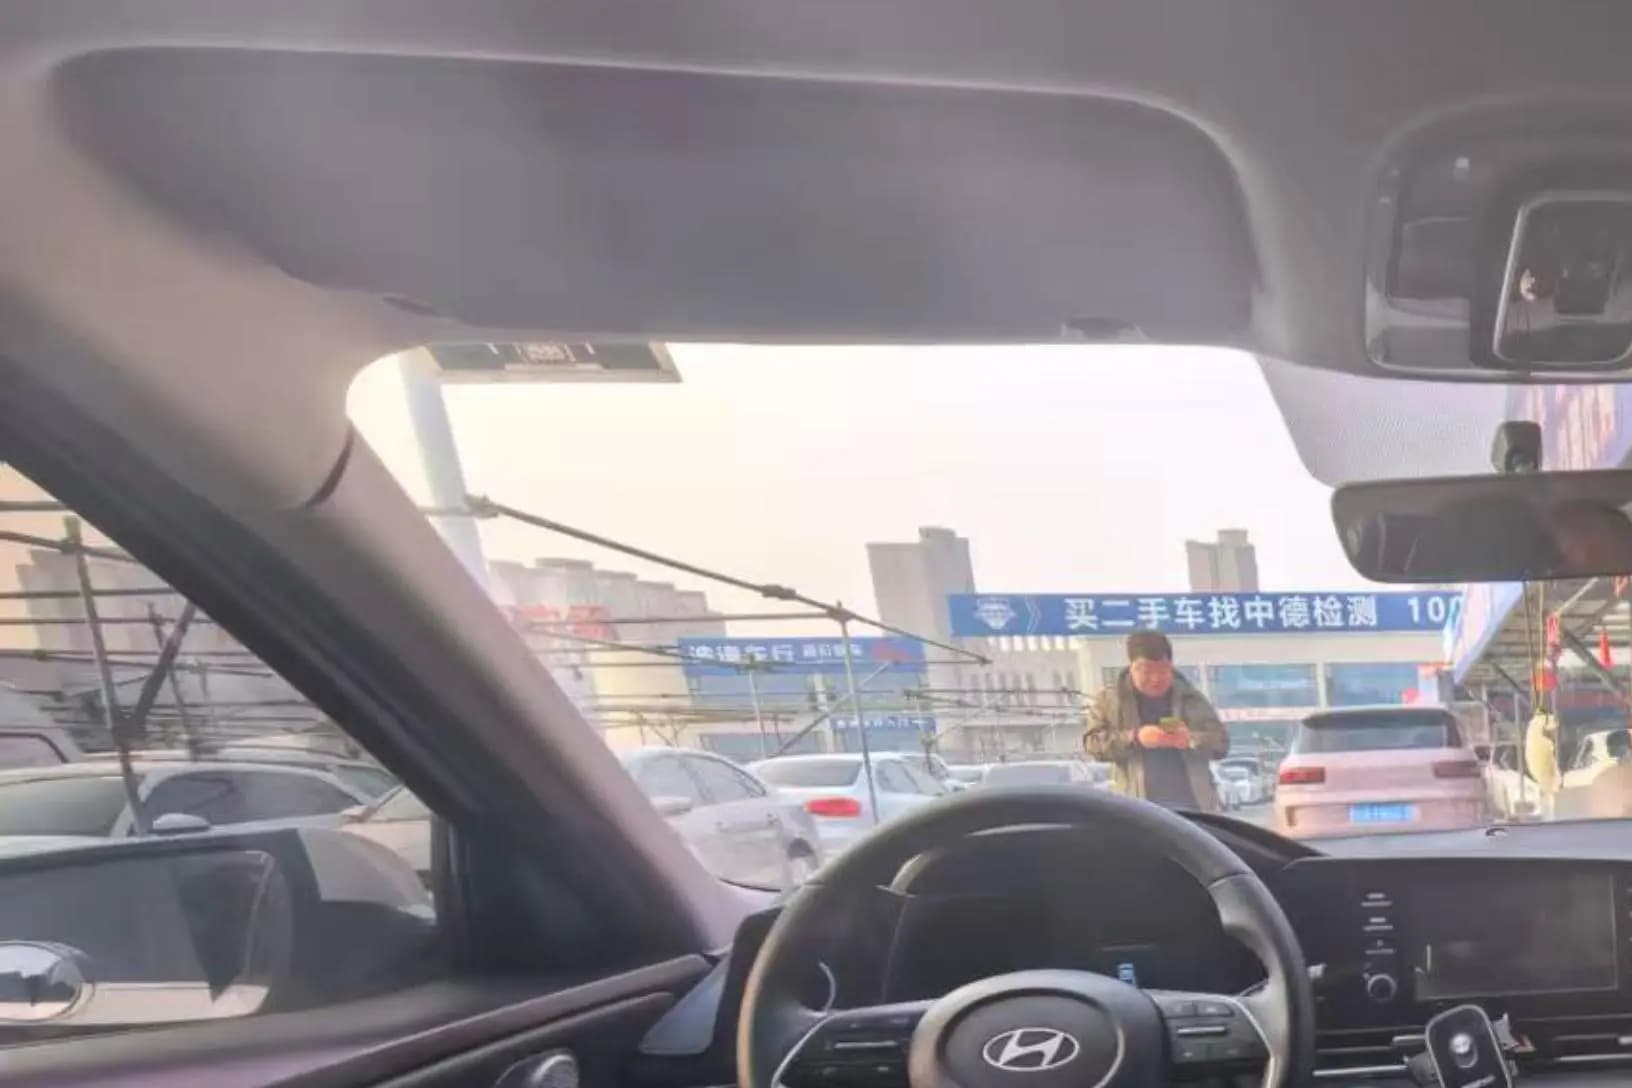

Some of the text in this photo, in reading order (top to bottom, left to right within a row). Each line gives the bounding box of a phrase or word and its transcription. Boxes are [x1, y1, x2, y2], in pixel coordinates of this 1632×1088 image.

[1063, 595, 1378, 630] 买二手车找中德检测
